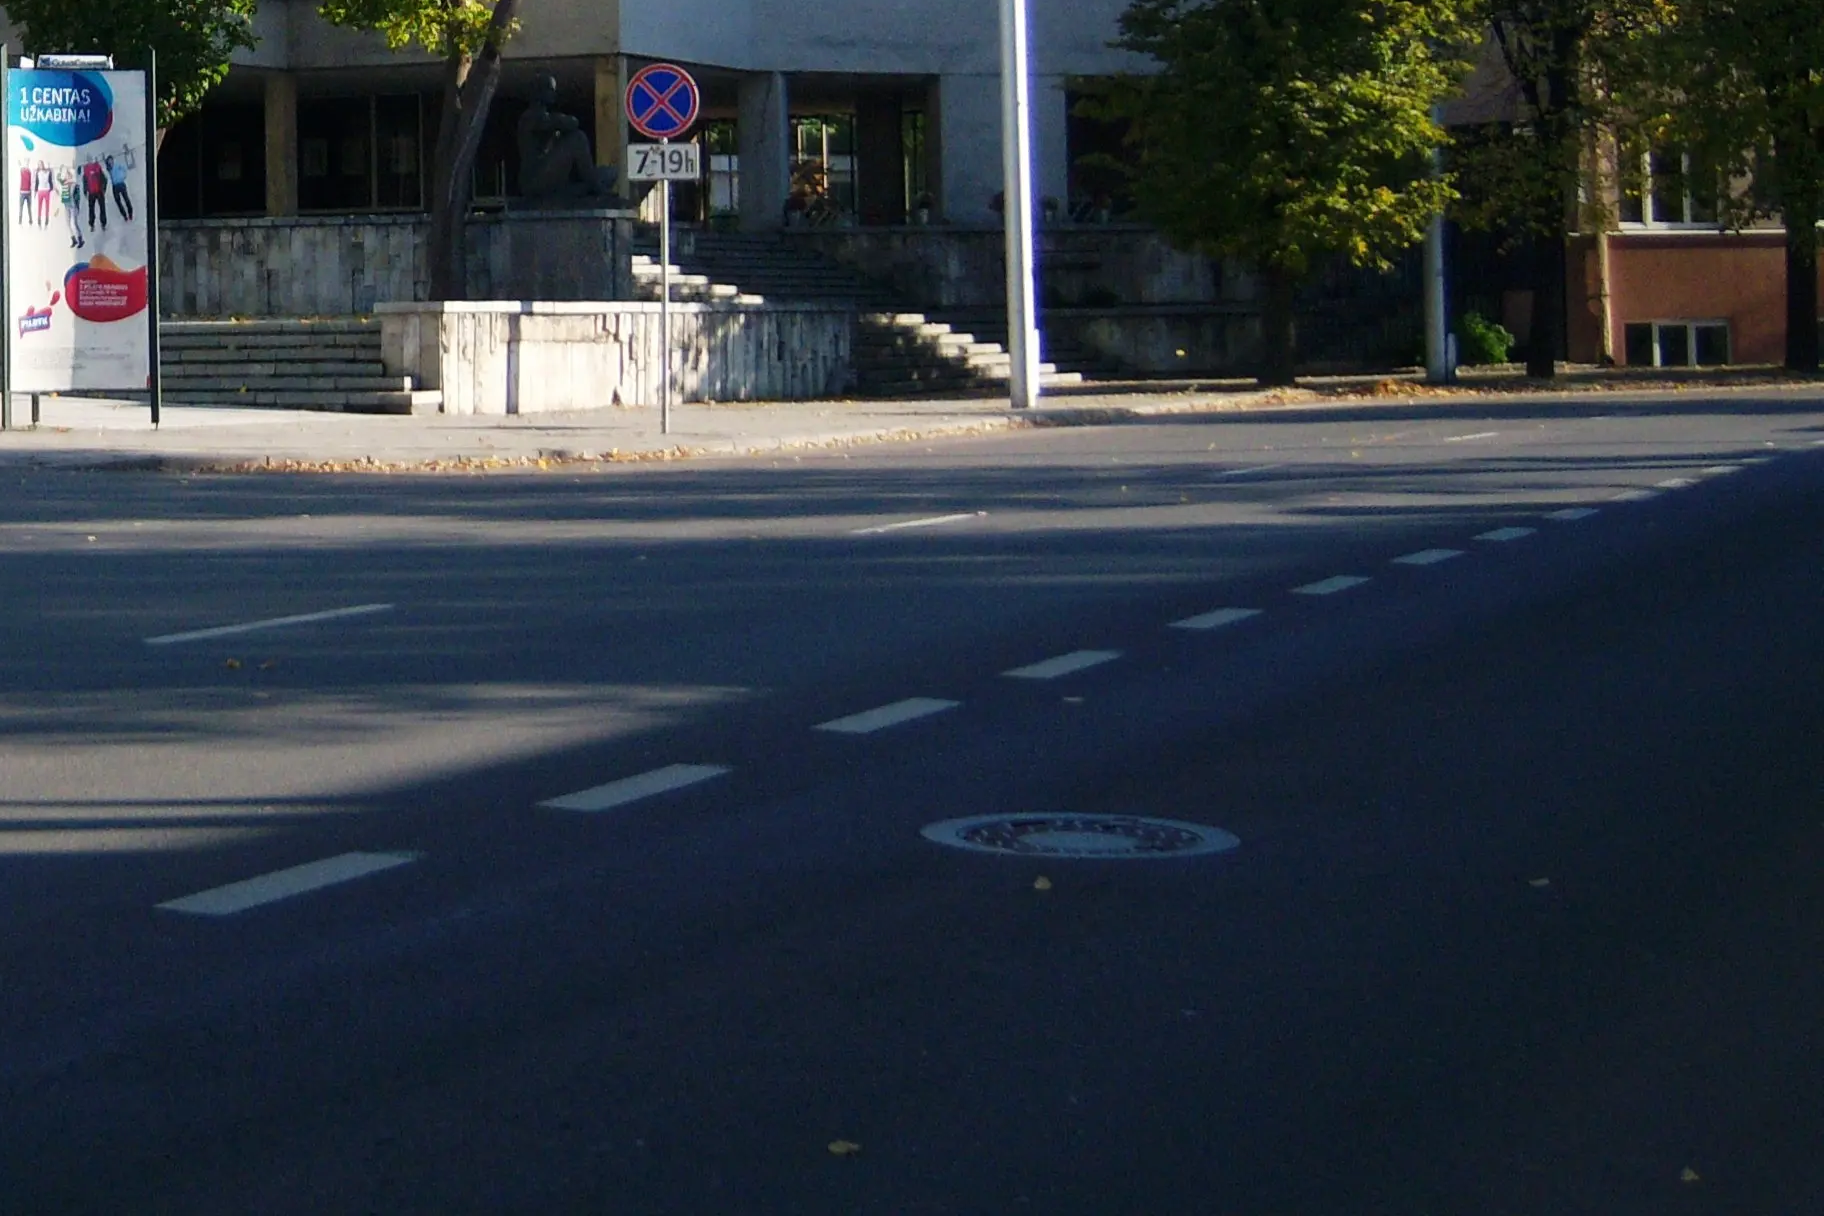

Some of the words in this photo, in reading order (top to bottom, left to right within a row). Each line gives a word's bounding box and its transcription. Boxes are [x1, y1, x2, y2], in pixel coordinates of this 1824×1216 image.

[20, 87, 29, 104] 1
[32, 87, 91, 105] CENTAS
[20, 104, 91, 123] UŽKABINA!
[635, 149, 694, 174] 7-19h
